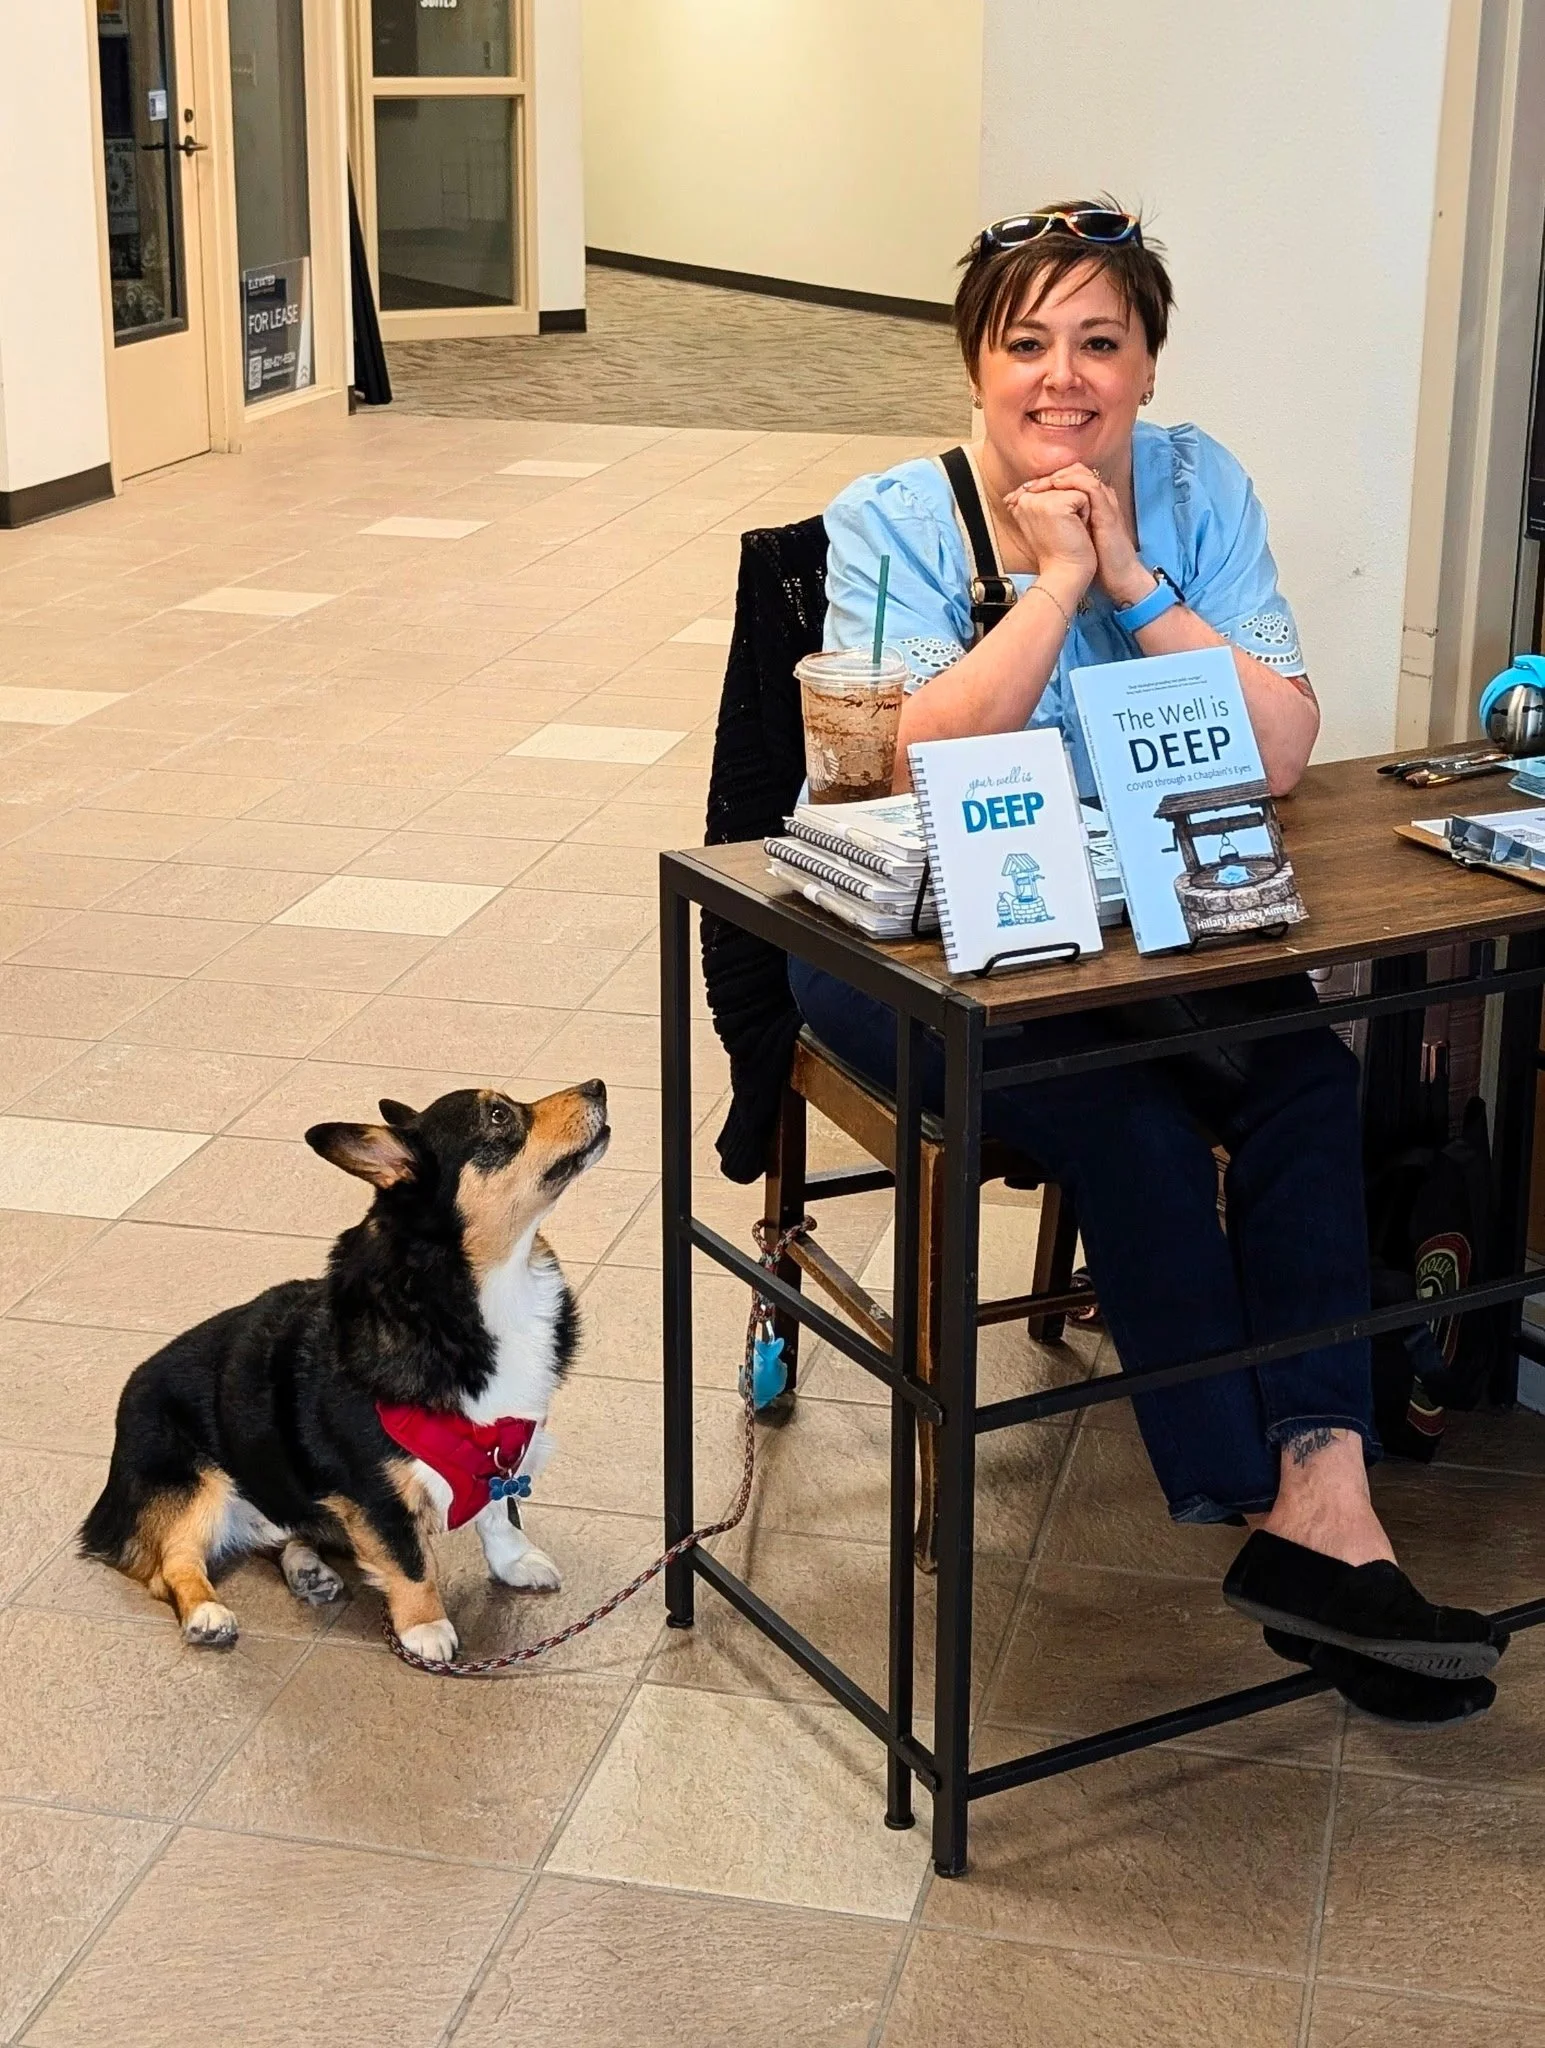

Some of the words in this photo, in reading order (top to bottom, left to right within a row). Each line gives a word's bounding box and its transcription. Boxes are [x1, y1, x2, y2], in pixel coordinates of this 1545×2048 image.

[248, 310, 269, 335] FOR
[270, 304, 299, 330] LEASE
[1113, 708, 1155, 732] The
[1158, 697, 1207, 725] Well
[1209, 695, 1229, 718] is
[1128, 726, 1231, 774] DEEP
[965, 776, 993, 800] your
[996, 766, 1021, 787] well
[1022, 772, 1033, 782] is
[1126, 779, 1154, 792] COVID
[1154, 774, 1186, 787] through
[1187, 773, 1193, 781] a
[1193, 767, 1233, 780] Chaplain's
[1233, 764, 1252, 776] Eyes
[961, 791, 1045, 834] DEEP
[1196, 916, 1227, 930] Hillary
[1228, 908, 1265, 922] Beasley
[1264, 903, 1298, 917] Kimsey
